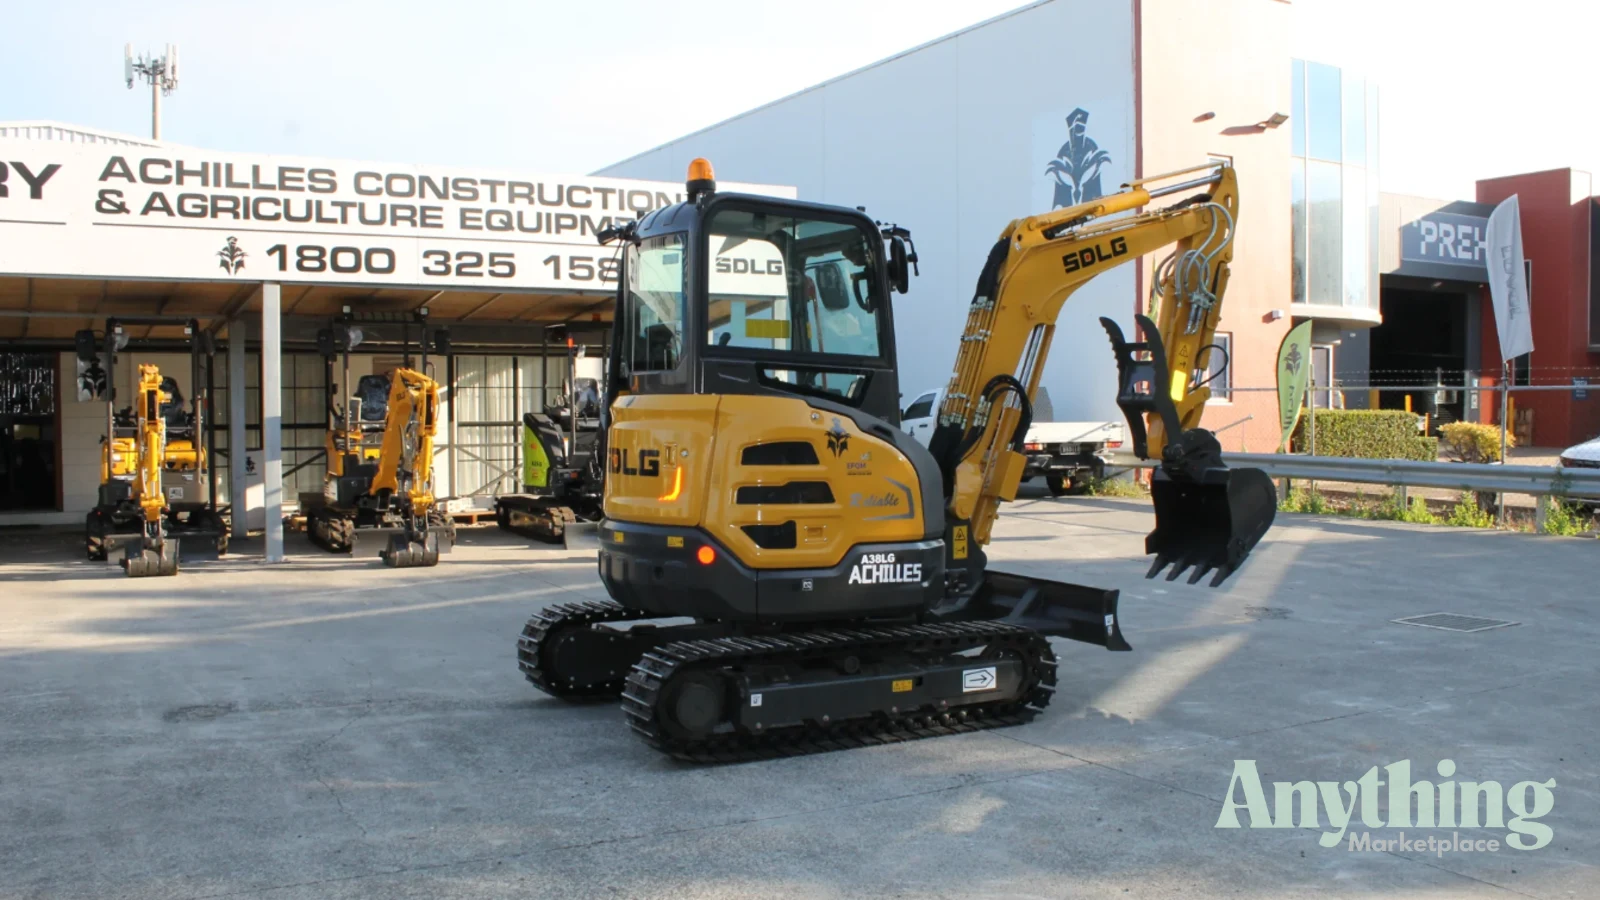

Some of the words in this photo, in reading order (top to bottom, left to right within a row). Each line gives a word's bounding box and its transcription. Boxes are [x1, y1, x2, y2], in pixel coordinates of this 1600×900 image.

[0, 161, 62, 200] Y
[98, 155, 338, 193] ACHILLES
[95, 188, 130, 214] &
[140, 191, 444, 229] AGRICULTURE
[459, 206, 636, 237] EQUIPM
[1062, 236, 1128, 274] SDLG
[1420, 220, 1487, 260] PREH
[266, 244, 396, 275] 1800
[422, 250, 516, 278] 325
[543, 253, 622, 281] 158
[716, 257, 782, 275] SDLG
[608, 447, 660, 477] DLG
[848, 563, 922, 585] ACHILLES
[861, 553, 896, 564] A38LG
